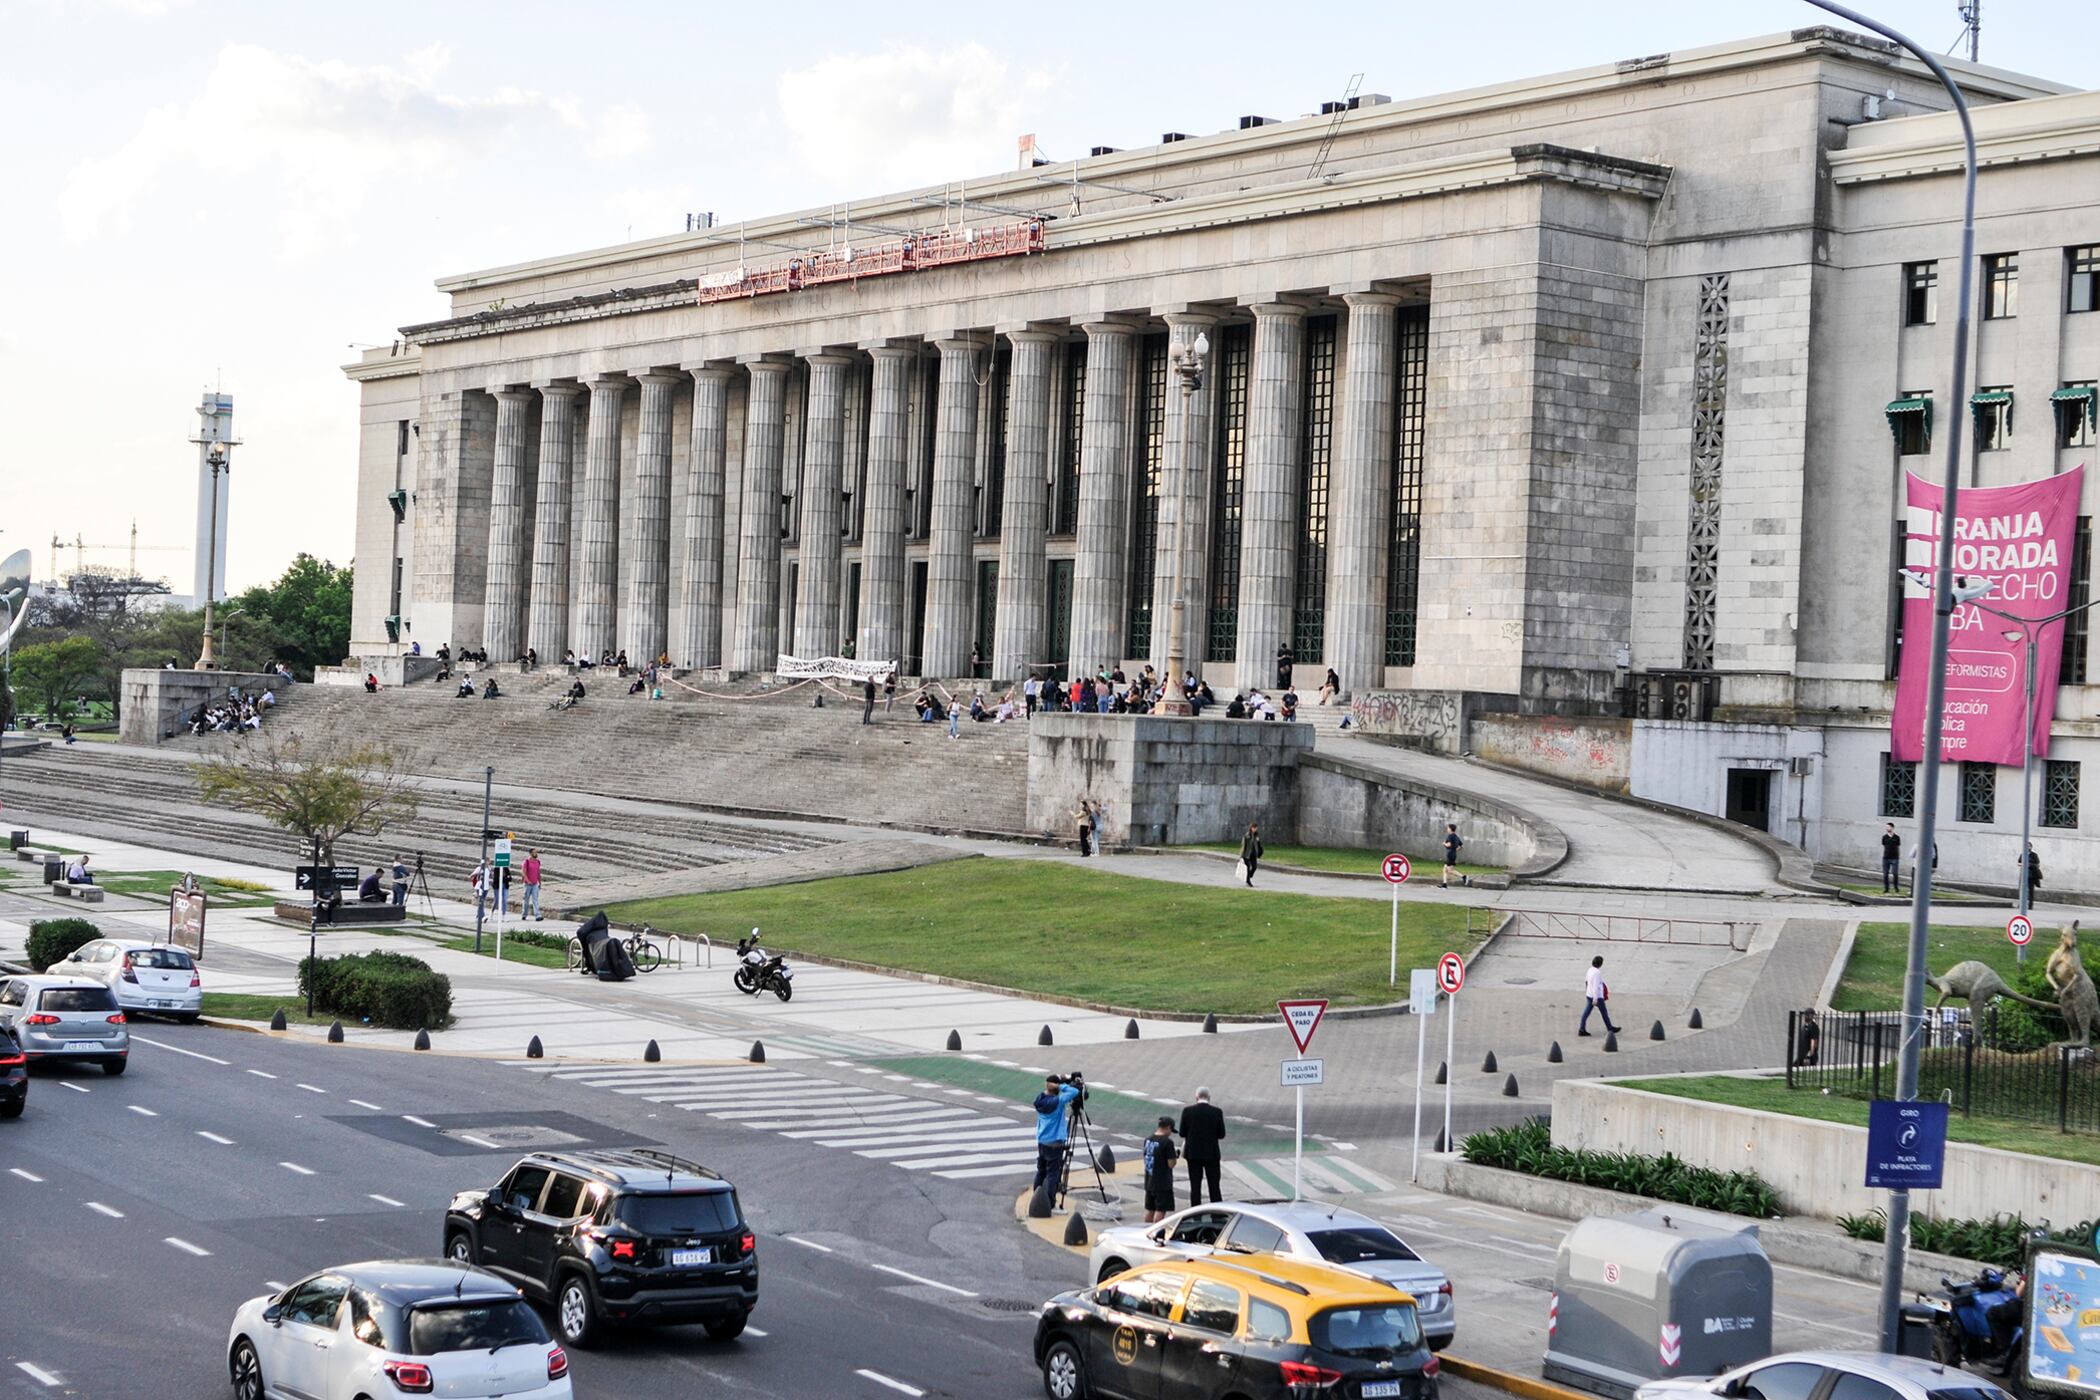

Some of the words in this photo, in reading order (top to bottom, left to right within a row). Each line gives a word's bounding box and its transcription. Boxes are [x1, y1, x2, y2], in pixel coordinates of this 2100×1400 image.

[1936, 604, 1984, 632] BA
[1945, 663, 2008, 679] EFORMISTAS
[2012, 924, 2027, 936] 20
[1292, 1064, 1318, 1072] CICLISTAS
[1291, 1072, 1318, 1080] PEATONES
[1900, 1109, 1920, 1117] GIRO
[1890, 1163, 1933, 1171] INFRACTORES
[1704, 1317, 1723, 1334] BA
